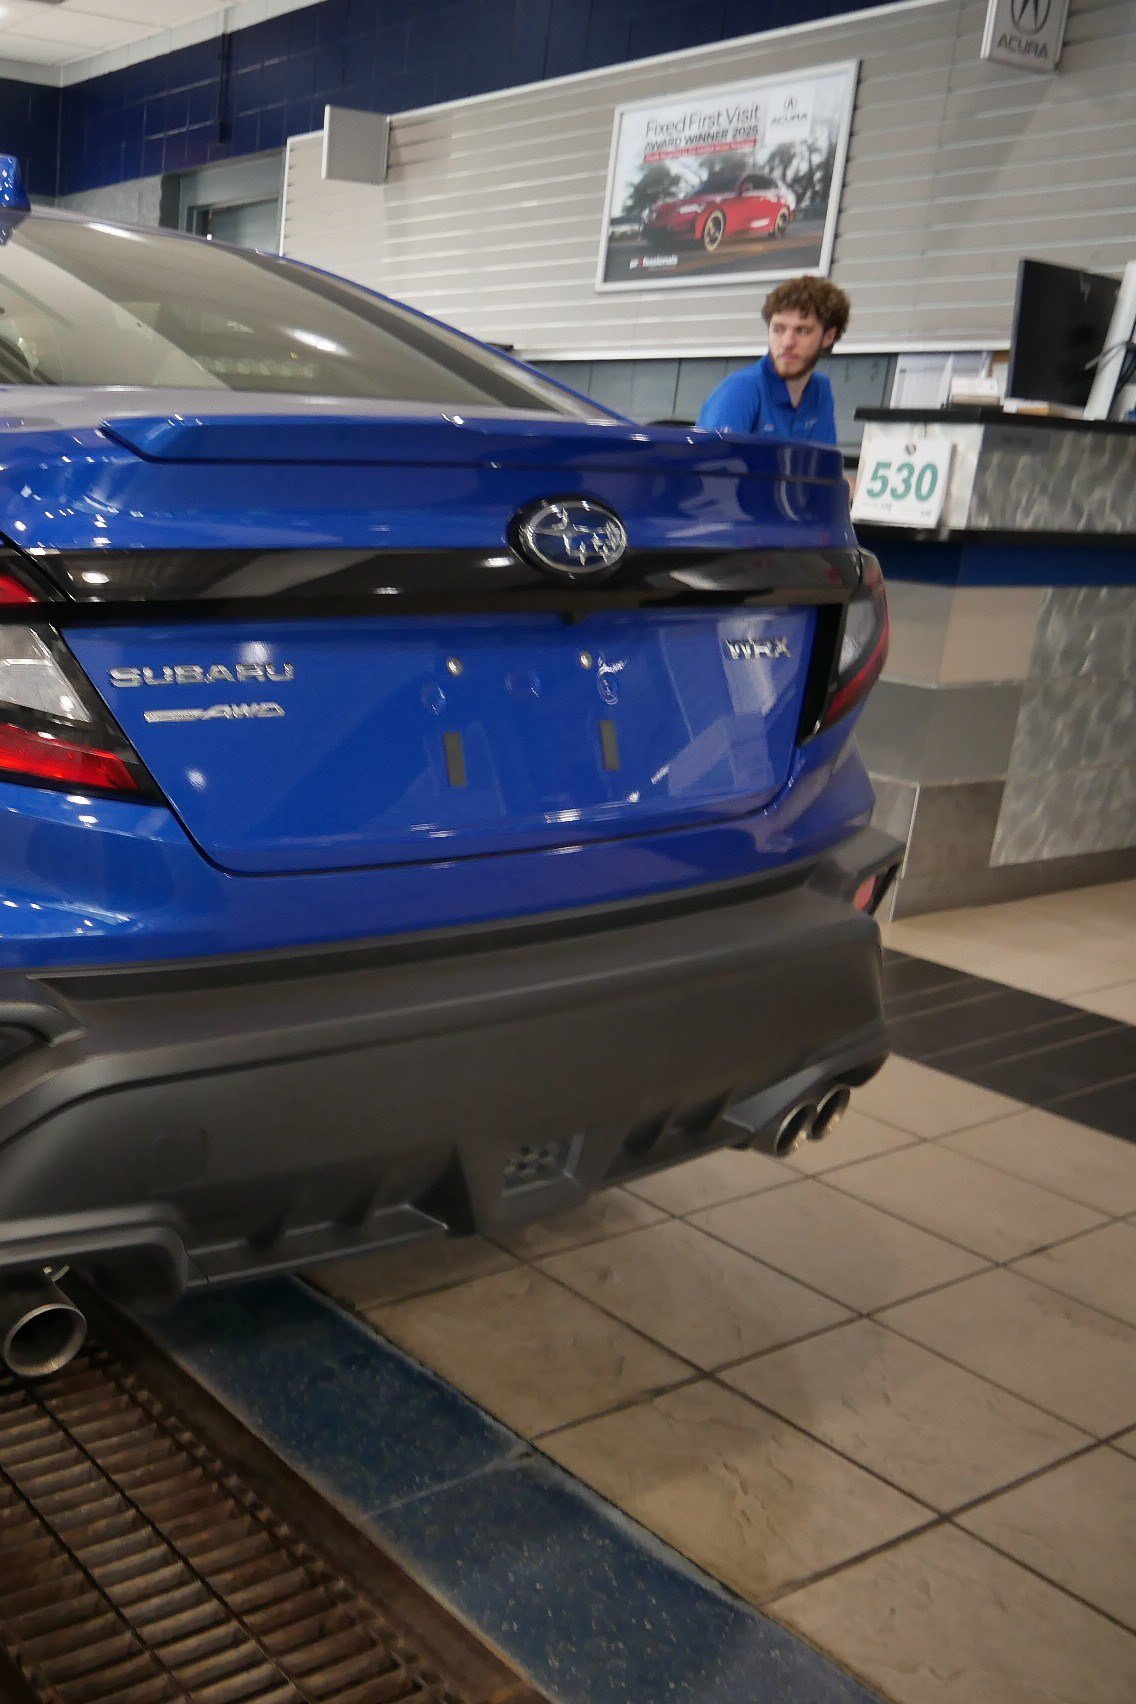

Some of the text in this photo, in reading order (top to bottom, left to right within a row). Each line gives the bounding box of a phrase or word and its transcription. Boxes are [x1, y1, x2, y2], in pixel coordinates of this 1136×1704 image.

[997, 32, 1048, 58] ACURA
[646, 105, 759, 138] Fixed First Visit
[644, 137, 681, 152] AWARD
[684, 130, 729, 147] WINNER
[866, 461, 939, 502] 530
[725, 636, 791, 660] WRX
[109, 662, 295, 688] SUBARU
[204, 701, 286, 721] AWD
